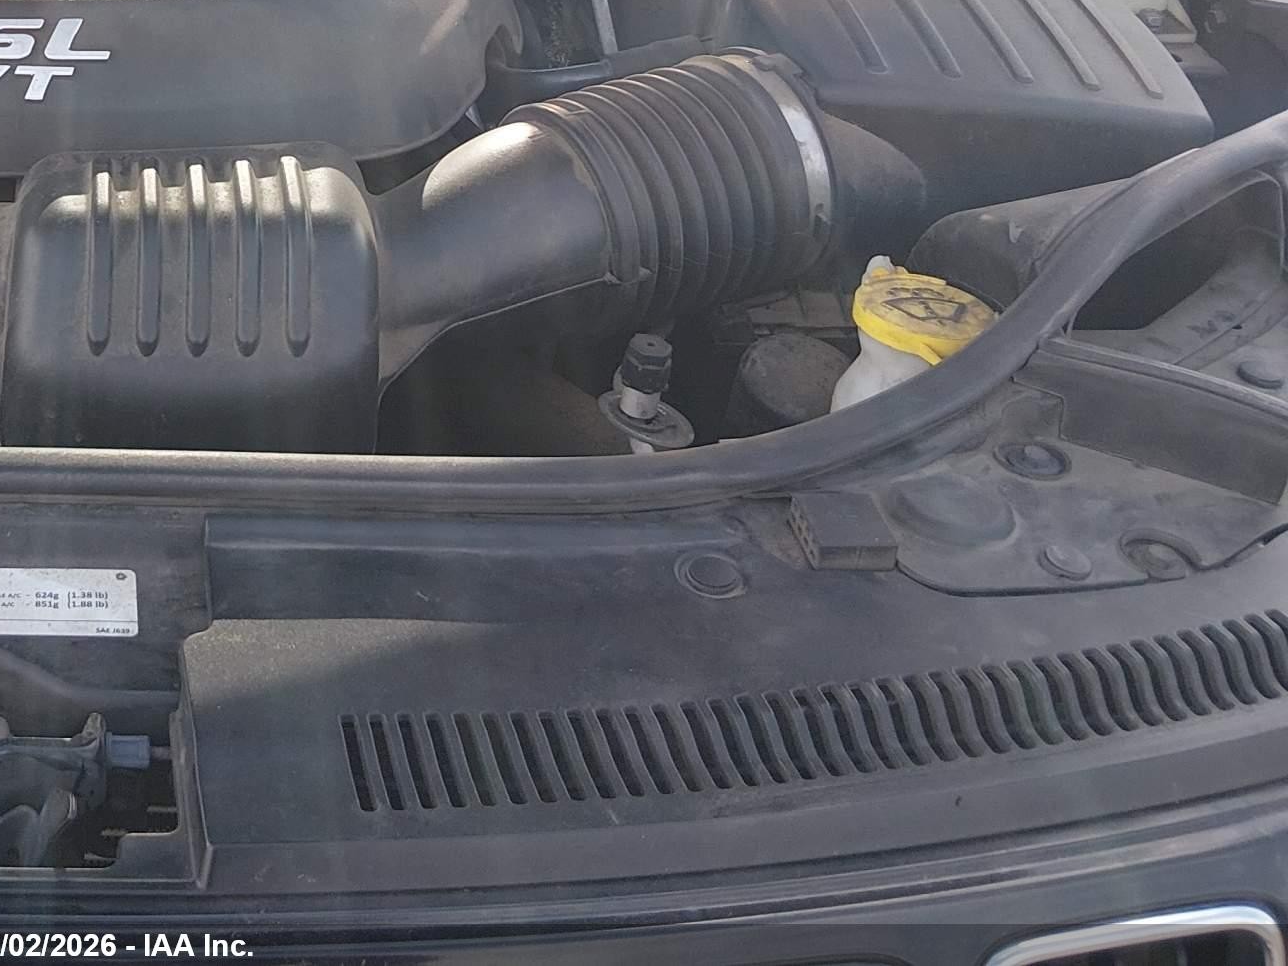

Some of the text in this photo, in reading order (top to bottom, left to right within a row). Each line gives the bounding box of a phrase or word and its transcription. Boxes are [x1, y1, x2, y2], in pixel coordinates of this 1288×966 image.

[35, 591, 60, 601] 624g
[67, 591, 93, 600] (1.38
[95, 591, 109, 600] lb)
[34, 600, 60, 610] 851g
[67, 600, 93, 609] (1.88
[95, 600, 109, 609] lb)
